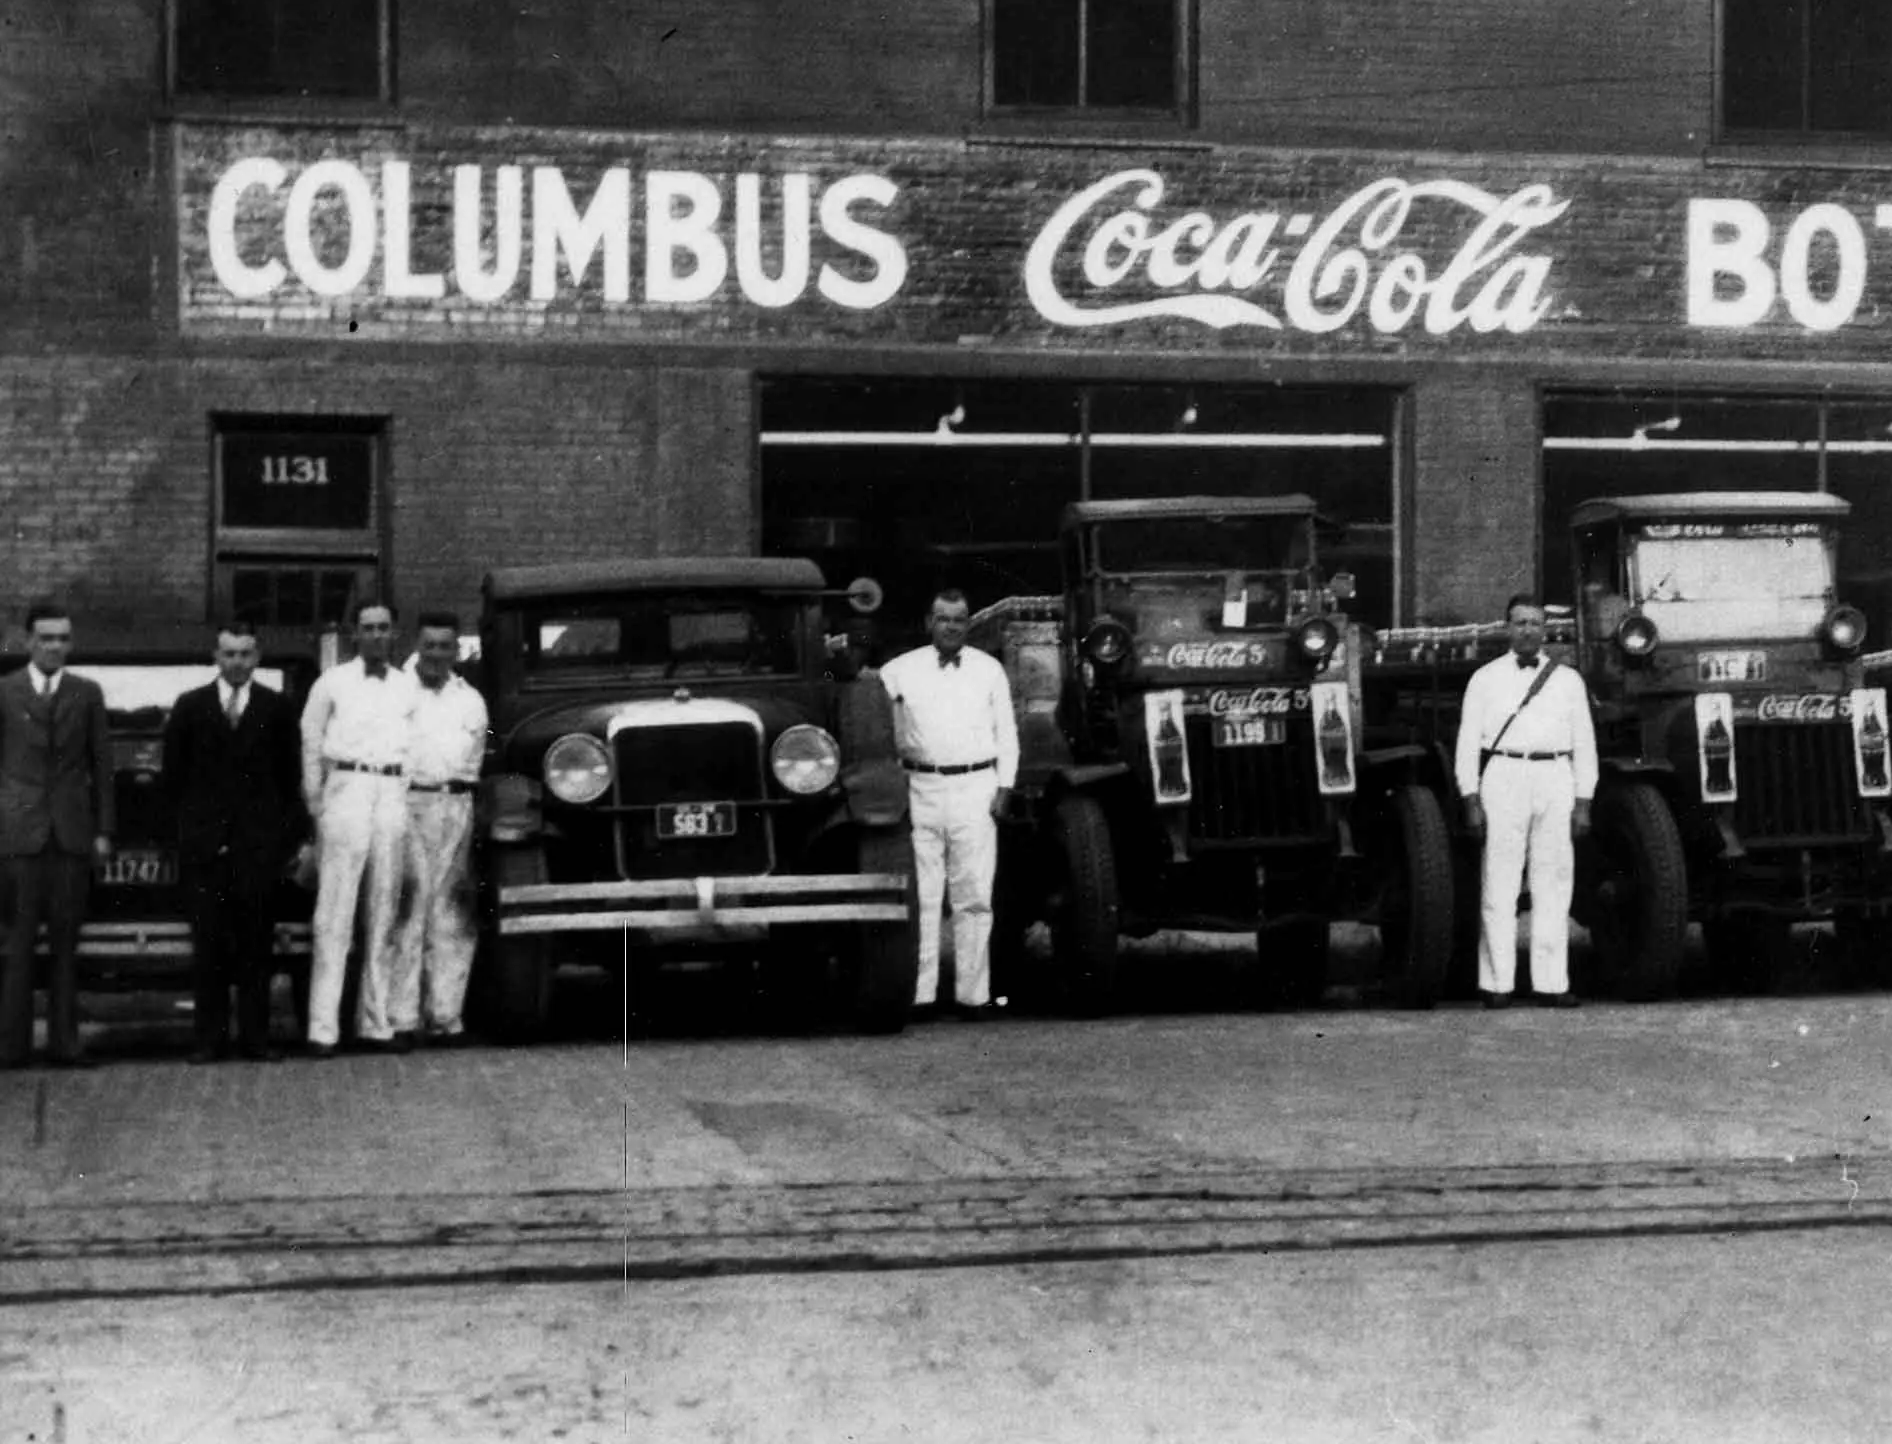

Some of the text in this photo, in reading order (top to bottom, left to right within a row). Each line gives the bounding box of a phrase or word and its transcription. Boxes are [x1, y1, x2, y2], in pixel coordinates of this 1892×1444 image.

[207, 155, 909, 310] COLUMBUS
[1024, 168, 1572, 335] Coca-Cola
[262, 456, 329, 484] 1131
